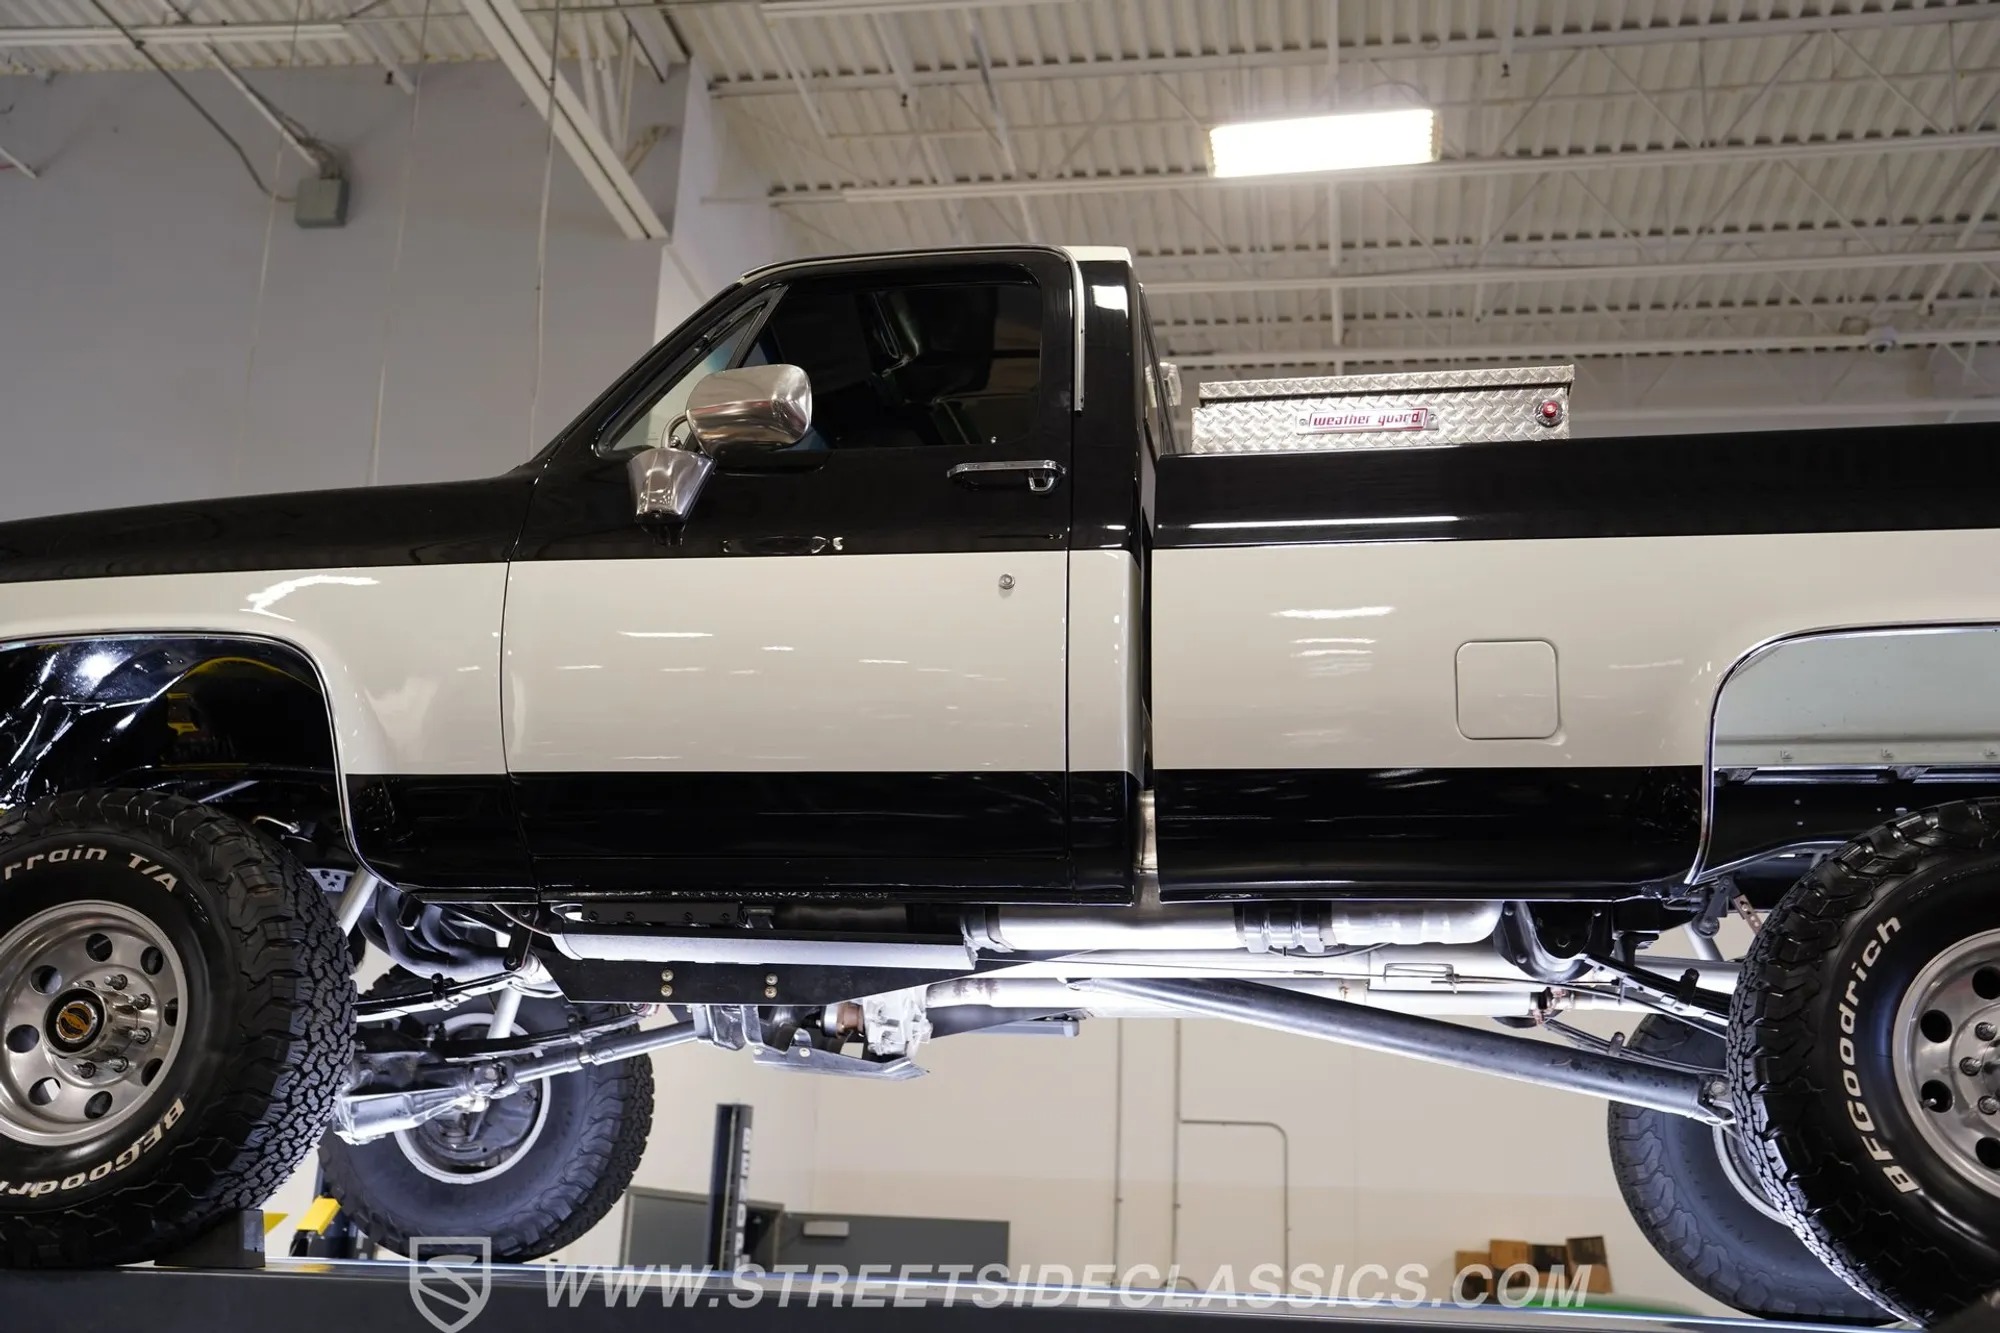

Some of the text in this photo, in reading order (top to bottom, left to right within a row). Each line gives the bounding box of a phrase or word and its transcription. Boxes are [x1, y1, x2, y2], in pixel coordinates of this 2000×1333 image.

[1313, 413, 1370, 426] weather
[4, 844, 178, 893] rrain T/A
[1839, 916, 1920, 1193] BFGoodrich
